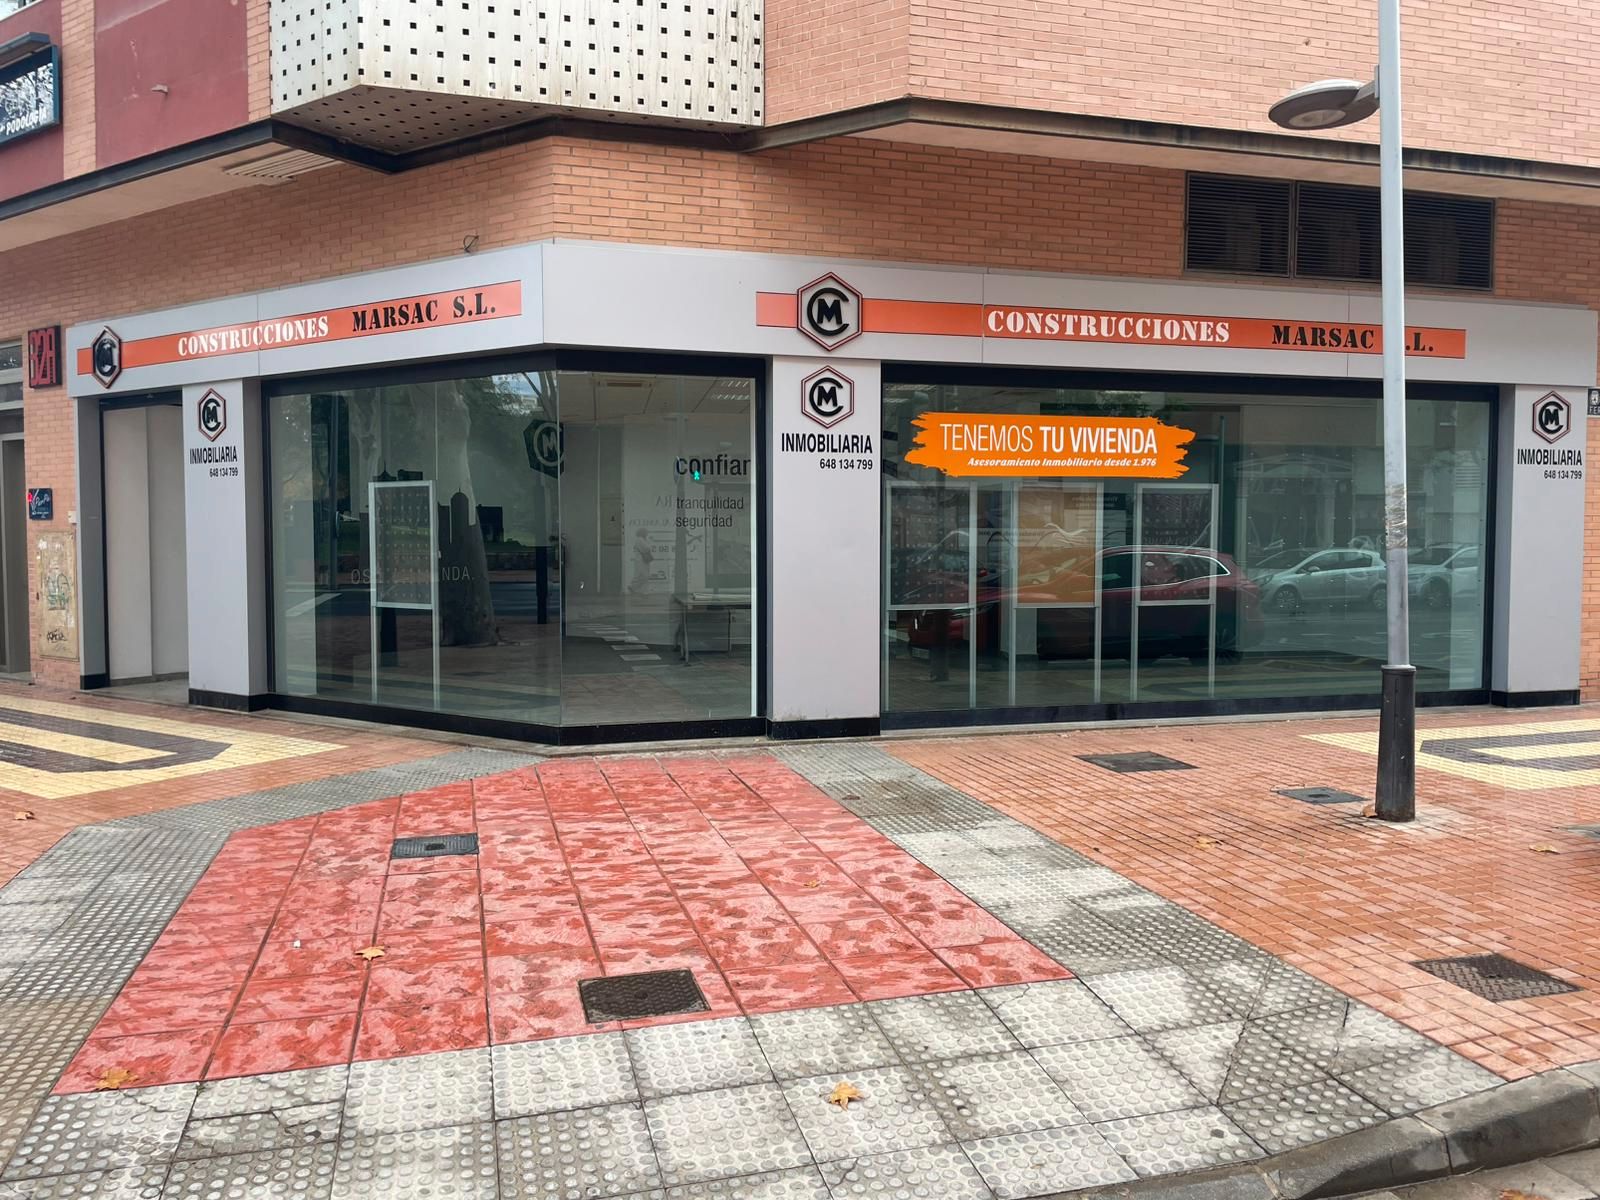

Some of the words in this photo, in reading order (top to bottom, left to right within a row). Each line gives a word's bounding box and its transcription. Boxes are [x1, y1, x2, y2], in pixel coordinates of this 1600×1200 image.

[178, 315, 330, 357] CONSTRUCCIONES
[352, 299, 439, 332] MARSAC
[453, 292, 497, 319] S.L.
[987, 310, 1230, 343] CONSTRUCCIONES
[1272, 325, 1375, 349] MARSAC
[781, 432, 873, 454] INMOBILIARIA
[939, 423, 1034, 453] TENEMOS
[1039, 426, 1064, 453] TU
[1069, 427, 1158, 454] VIVIENDA
[189, 445, 238, 465] INMOBILIARIA
[967, 456, 1041, 467] Asesoramiento
[1042, 457, 1103, 468] Inmobiliario
[1103, 458, 1133, 467] desde
[1133, 458, 1157, 467] 1.976
[1517, 448, 1583, 466] INMOBILIARIA
[209, 467, 219, 477] 648
[219, 467, 228, 477] 134
[228, 467, 239, 477] 799
[819, 458, 837, 469] 648
[838, 459, 855, 470] 134
[856, 459, 873, 470] 799
[1543, 469, 1557, 479] 648
[1557, 470, 1569, 479] 134
[1569, 470, 1583, 479] 799
[676, 496, 744, 512] tranquilidad
[675, 514, 733, 529] seguridad
